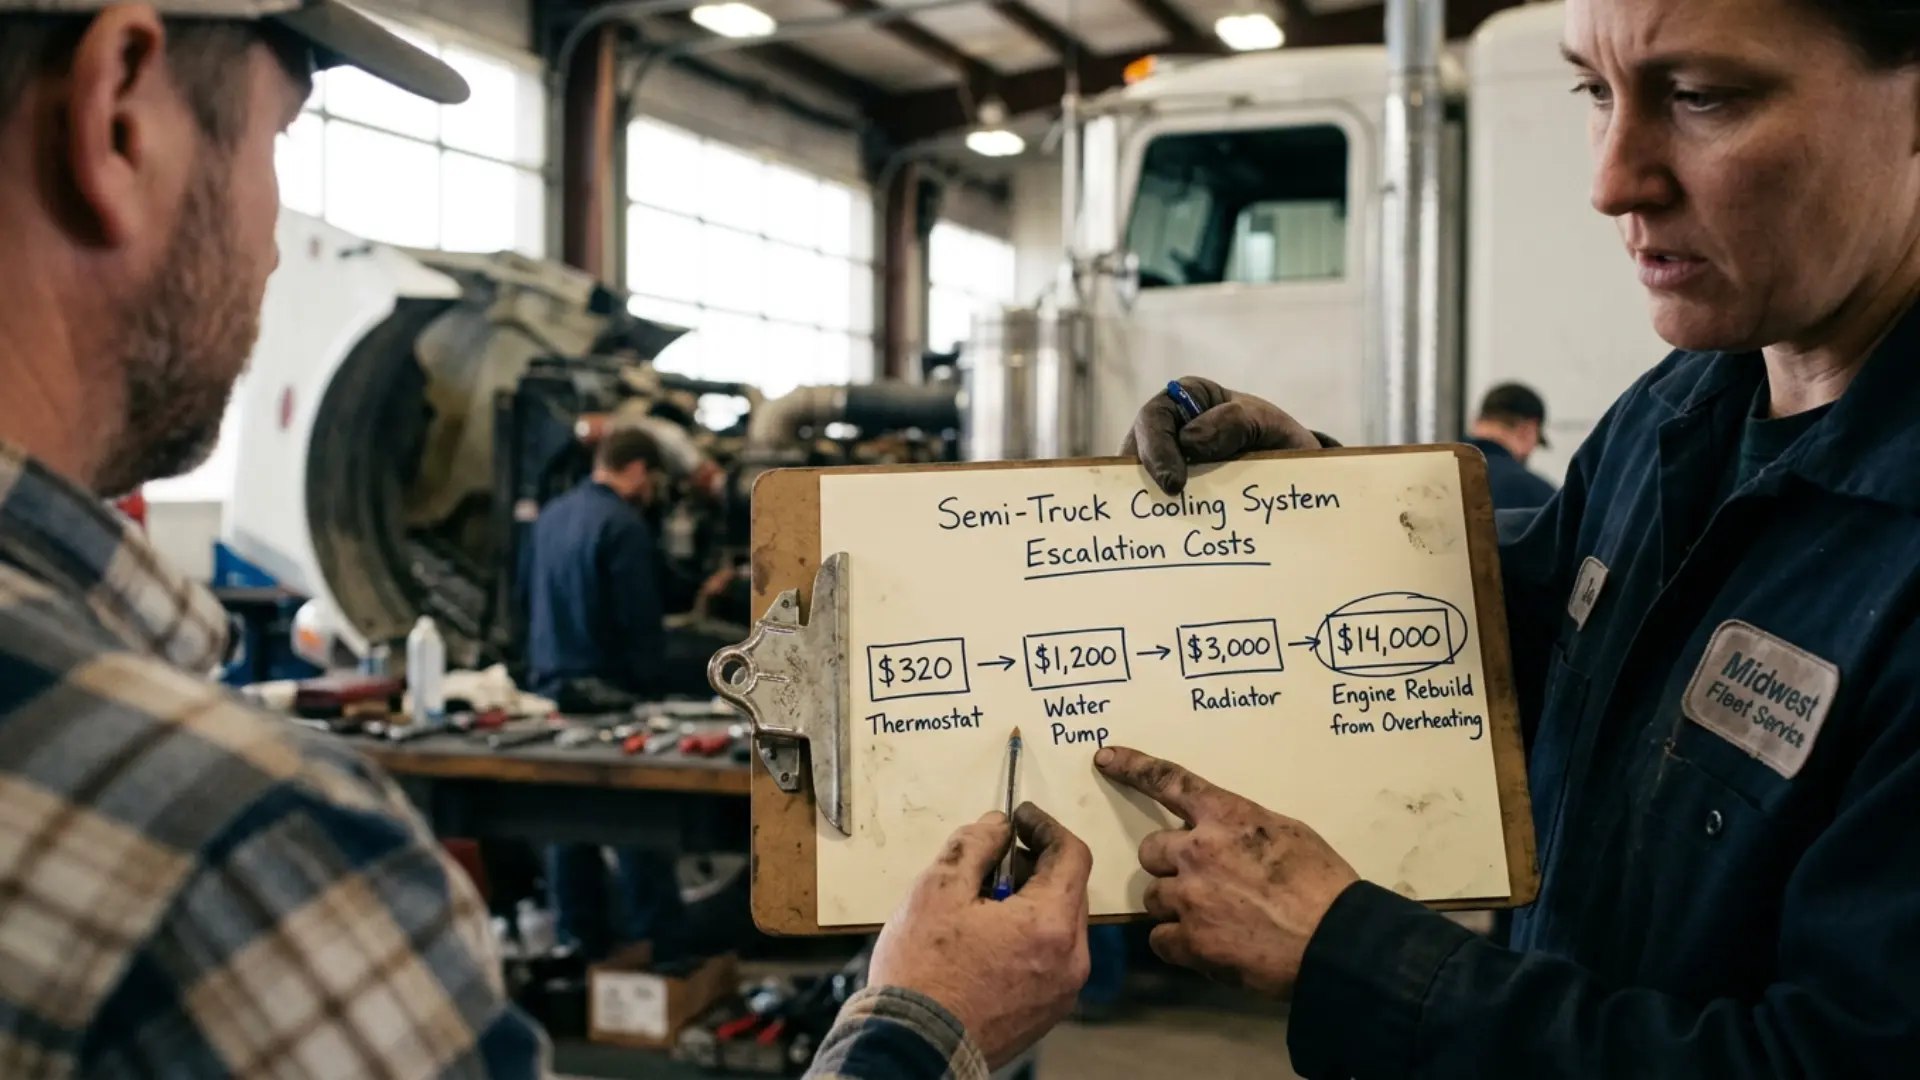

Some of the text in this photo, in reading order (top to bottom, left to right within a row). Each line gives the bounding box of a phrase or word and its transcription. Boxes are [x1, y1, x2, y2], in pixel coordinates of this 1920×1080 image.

[938, 484, 1340, 530] Semi-Truck Cooling System
[1026, 529, 1256, 568] Escalation Costs
[1188, 634, 1270, 663] $3,000
[1338, 623, 1441, 656] $14,000
[879, 654, 952, 688] $320
[1035, 643, 1116, 675] $1,200
[1191, 686, 1282, 711] Radiator
[1332, 673, 1474, 712] Engine Rebuild
[1706, 681, 1753, 718] Fleet
[1721, 651, 1819, 722] Midwest
[865, 705, 983, 735] Thermostat
[1044, 694, 1110, 717] Water
[1051, 723, 1109, 749] Pump
[1330, 708, 1483, 740] from Overheating
